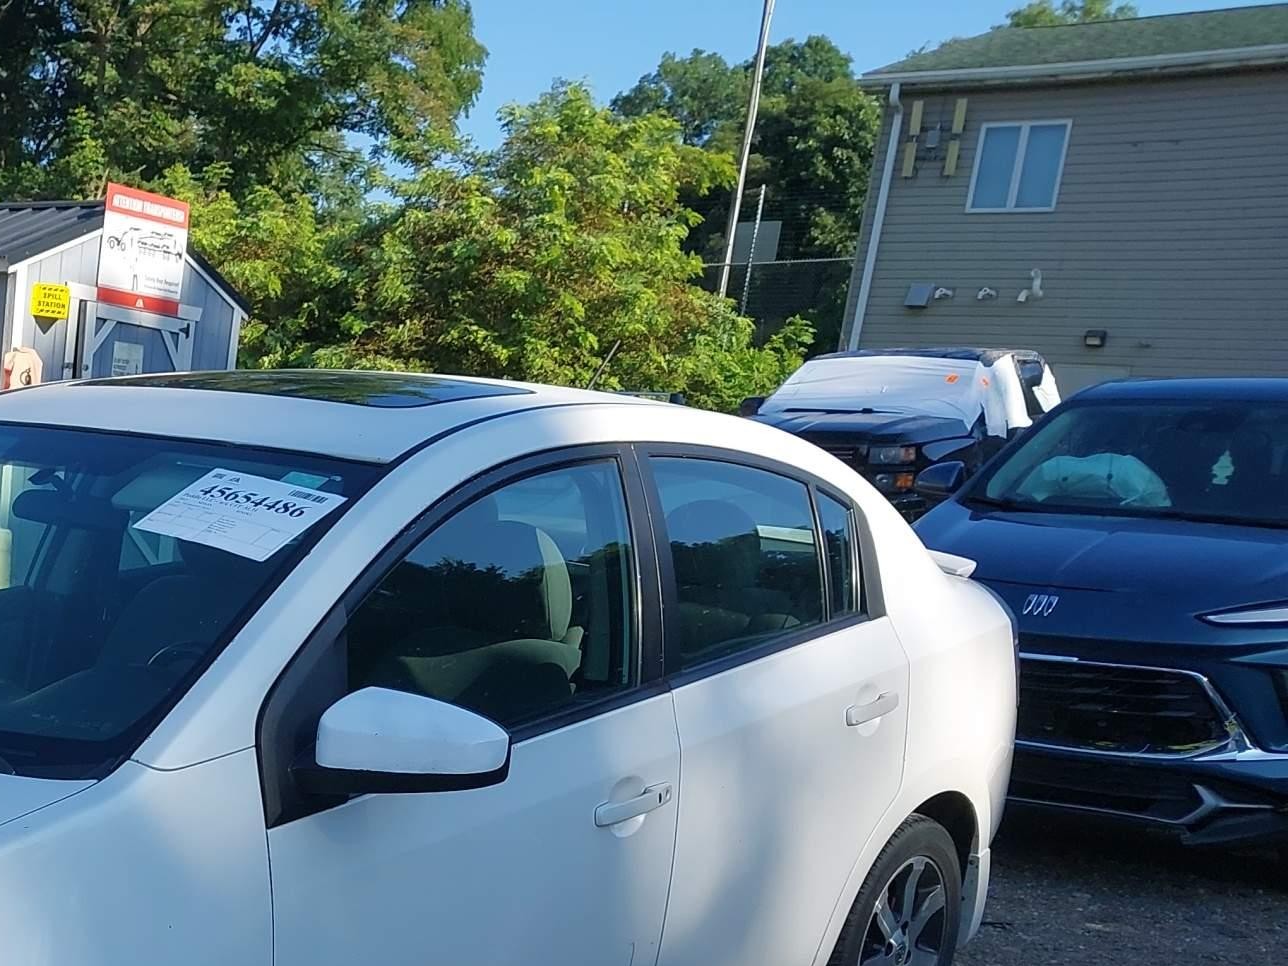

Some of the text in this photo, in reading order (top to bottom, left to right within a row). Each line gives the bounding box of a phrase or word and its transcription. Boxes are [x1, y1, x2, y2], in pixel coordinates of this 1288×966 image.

[44, 292, 62, 301] SPILL
[38, 300, 65, 309] STATION
[199, 485, 313, 518] 45654486
